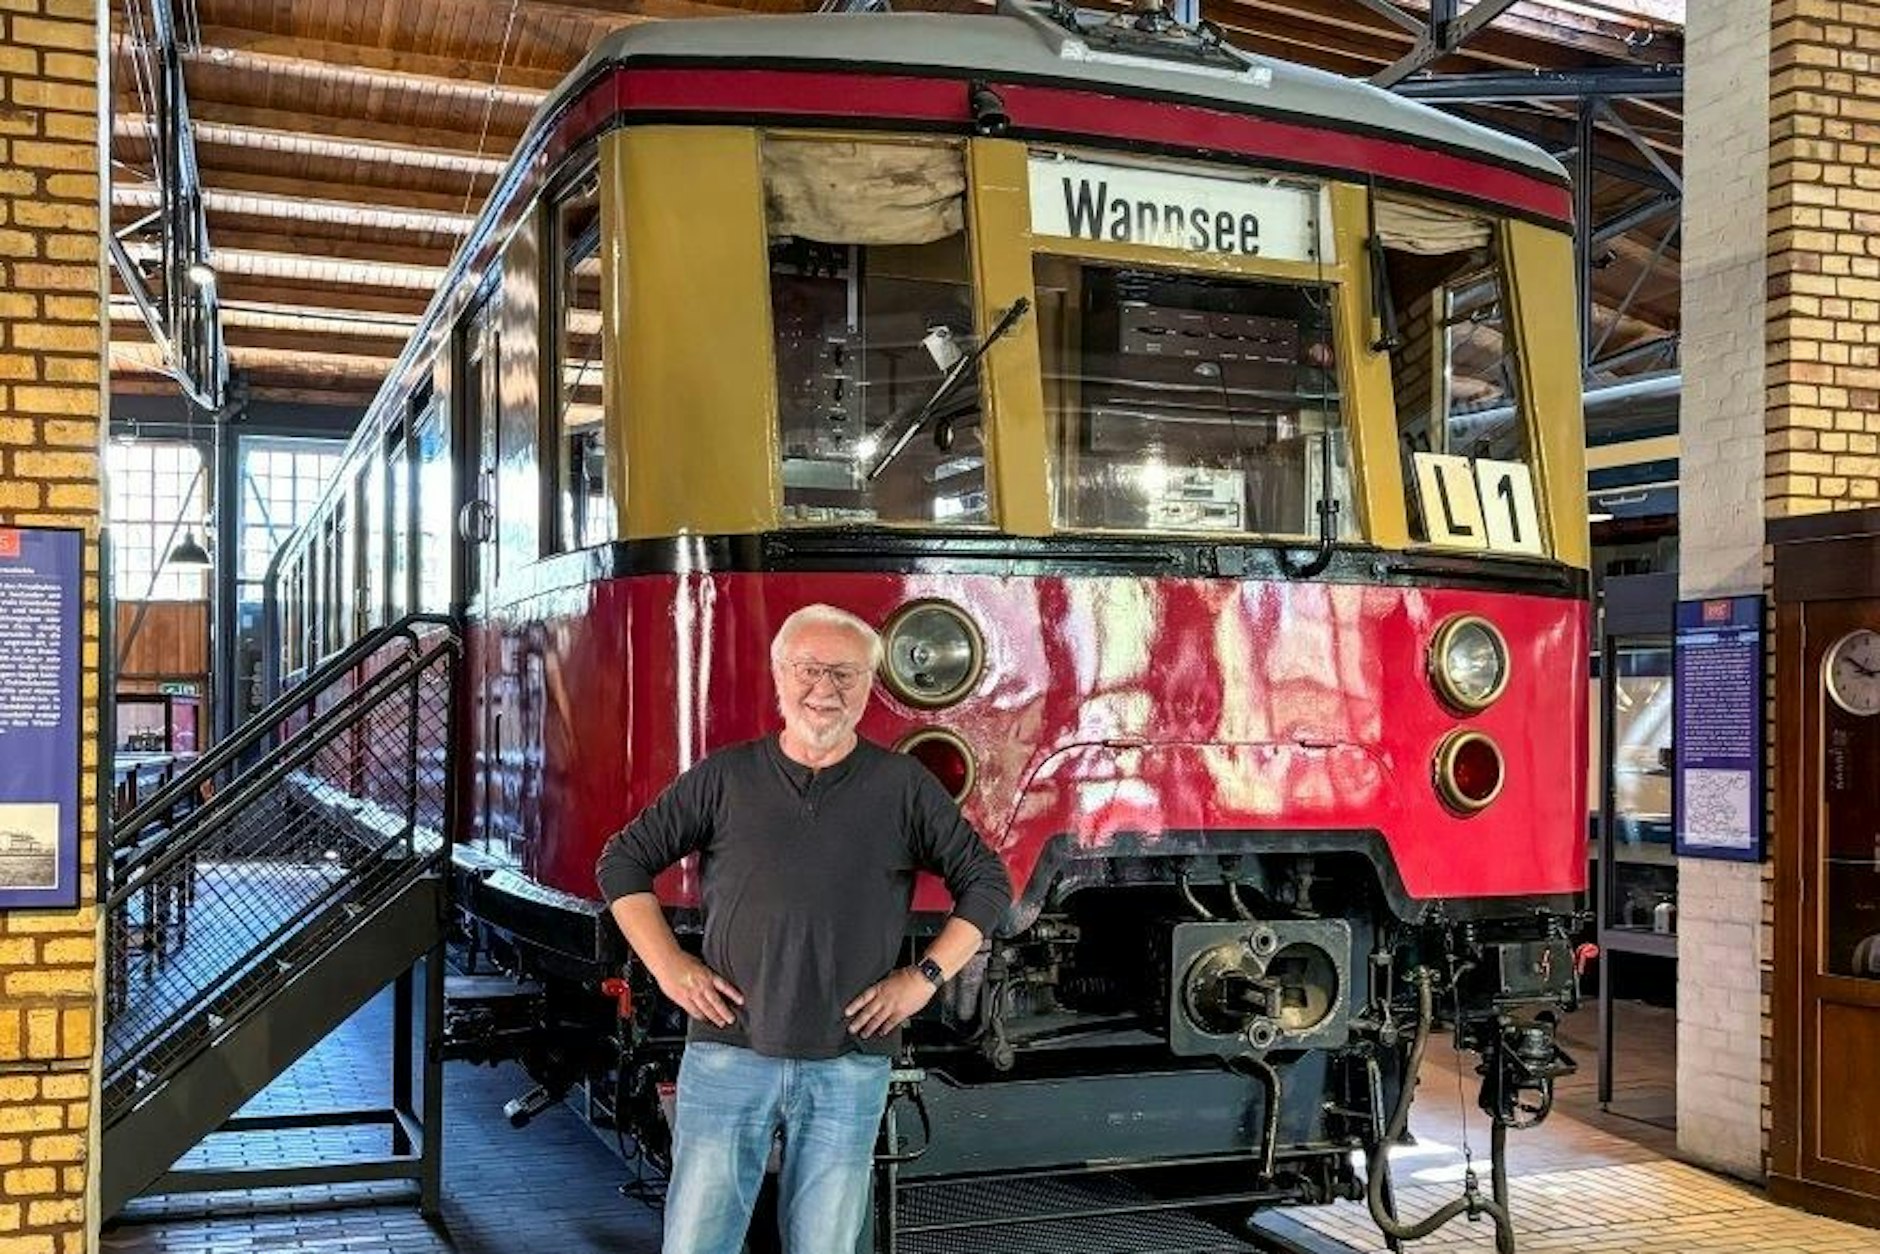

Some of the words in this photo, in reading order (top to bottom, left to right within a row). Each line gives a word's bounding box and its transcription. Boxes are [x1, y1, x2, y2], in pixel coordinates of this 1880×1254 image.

[1062, 177, 1260, 255] Wannsee
[1433, 464, 1473, 536] L
[1498, 474, 1521, 543] 1
